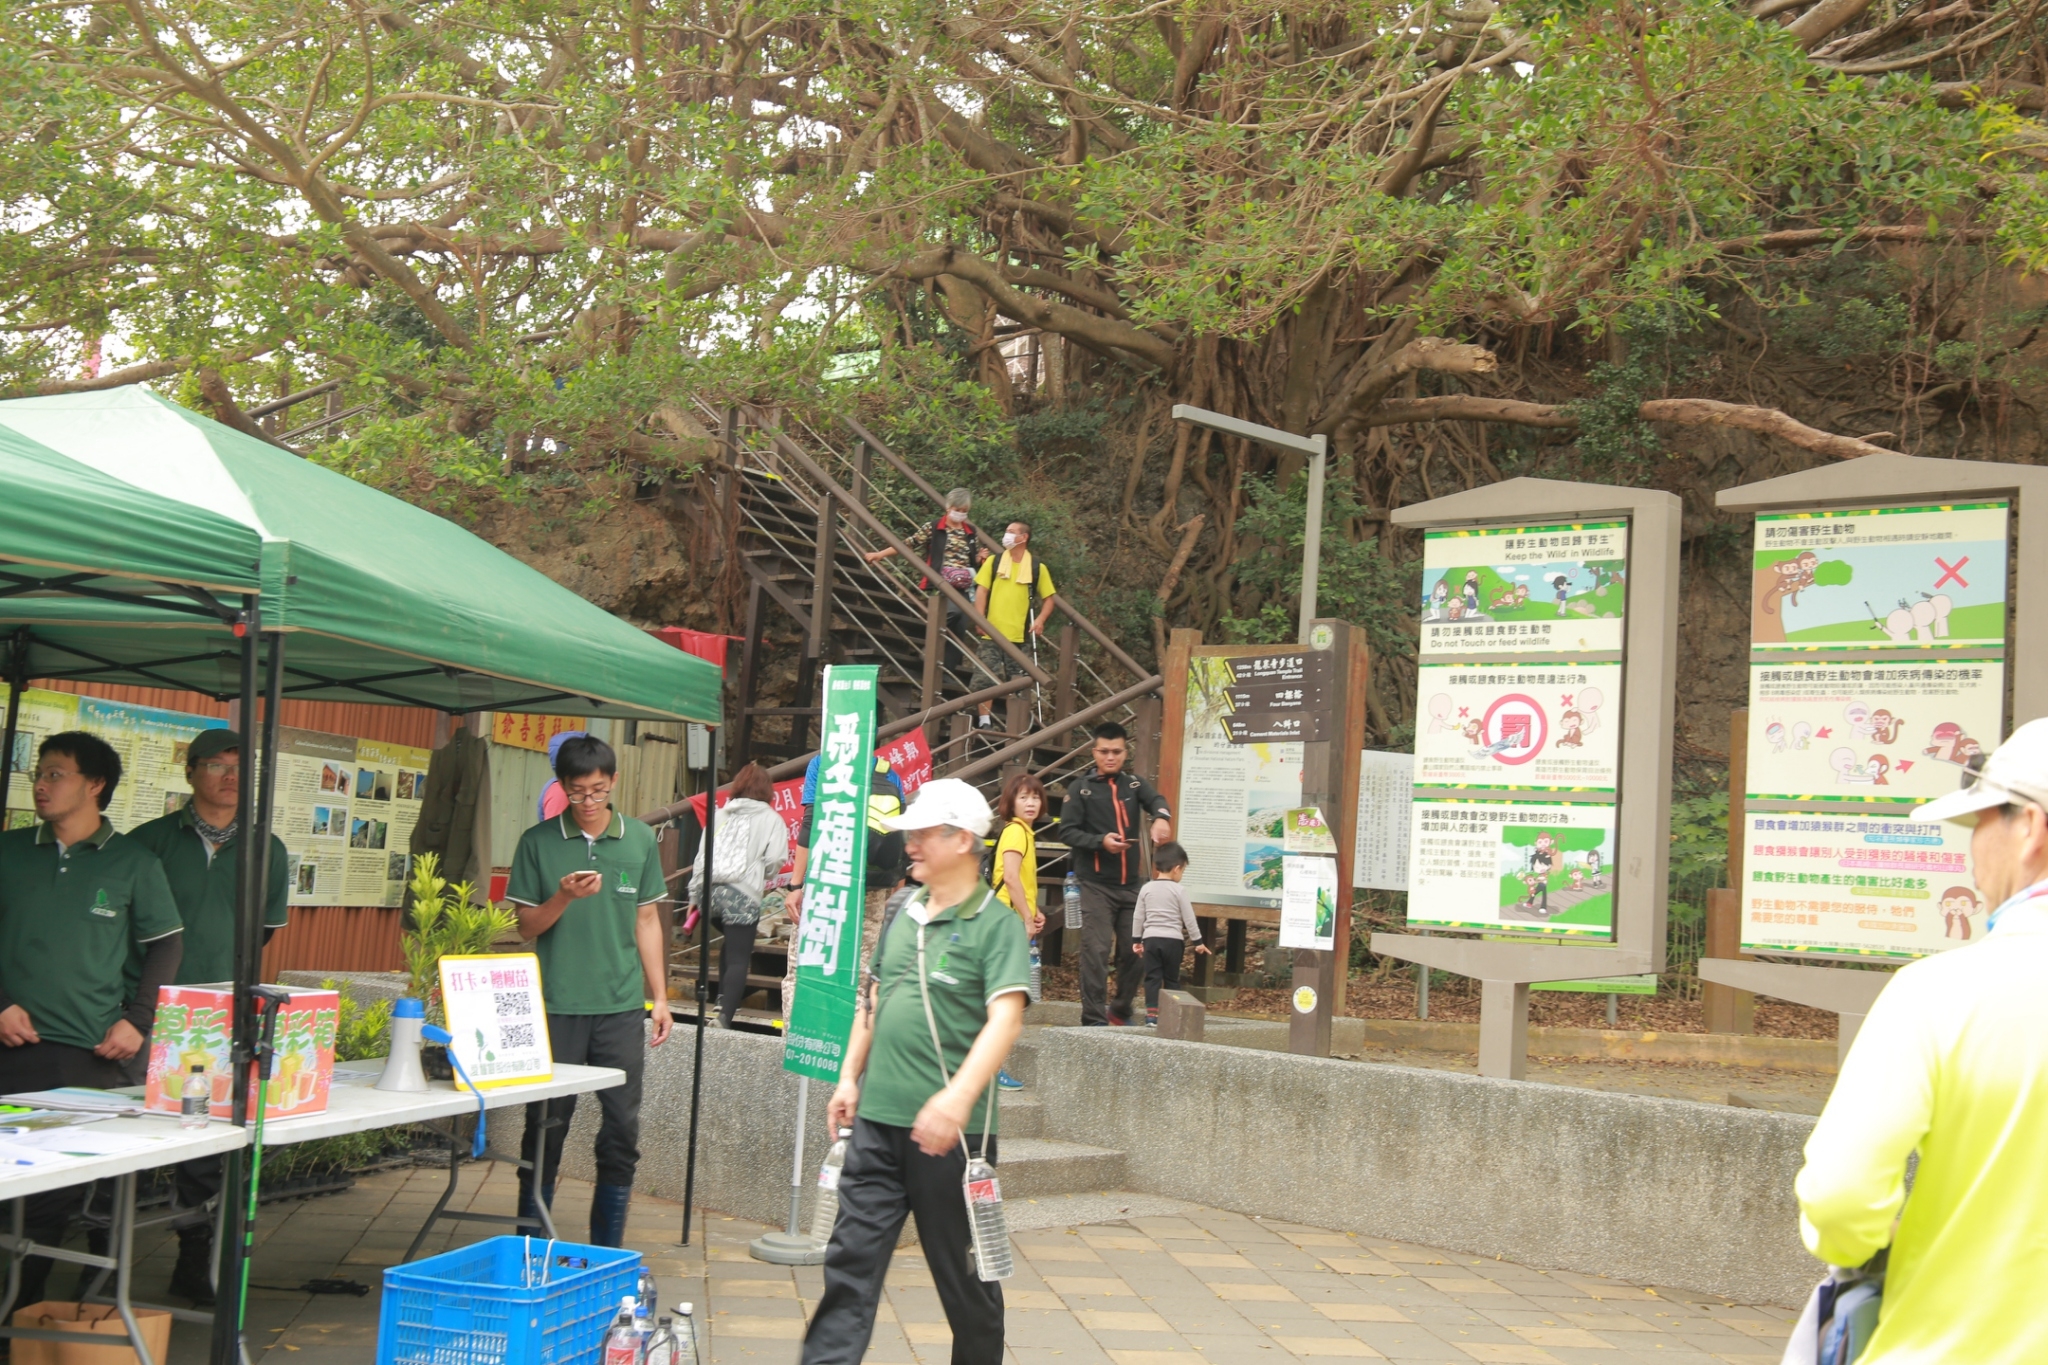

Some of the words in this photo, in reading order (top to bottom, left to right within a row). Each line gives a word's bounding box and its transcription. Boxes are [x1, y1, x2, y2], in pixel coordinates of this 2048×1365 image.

[1765, 524, 1855, 538] 請勿傷害野生動物
[1505, 551, 1528, 562] Keep
[1529, 551, 1543, 560] the
[1570, 549, 1579, 557] in
[1581, 548, 1615, 557] Wildlife
[1431, 624, 1552, 637] 請勿接觸或餵食野生動物
[1431, 639, 1442, 648] Do
[1444, 639, 1458, 648] not
[1460, 638, 1486, 648] Touch
[1487, 639, 1497, 647] or
[1498, 637, 1518, 646] feed
[1519, 636, 1551, 646] wildlife
[1449, 674, 1587, 685] 接觸或餵食野生動物是違法行為
[1760, 669, 1984, 682] 接觸或餵食野生動物會增加疾病傳染的機率
[1421, 822, 1488, 834] 增加與人的衝突
[797, 712, 860, 977] 愛種樹
[1752, 871, 1928, 890] 餵食野生動物產生的傷害比好處多
[1751, 911, 1818, 926] 需要您的尊重
[152, 1002, 238, 1049] 摸彩
